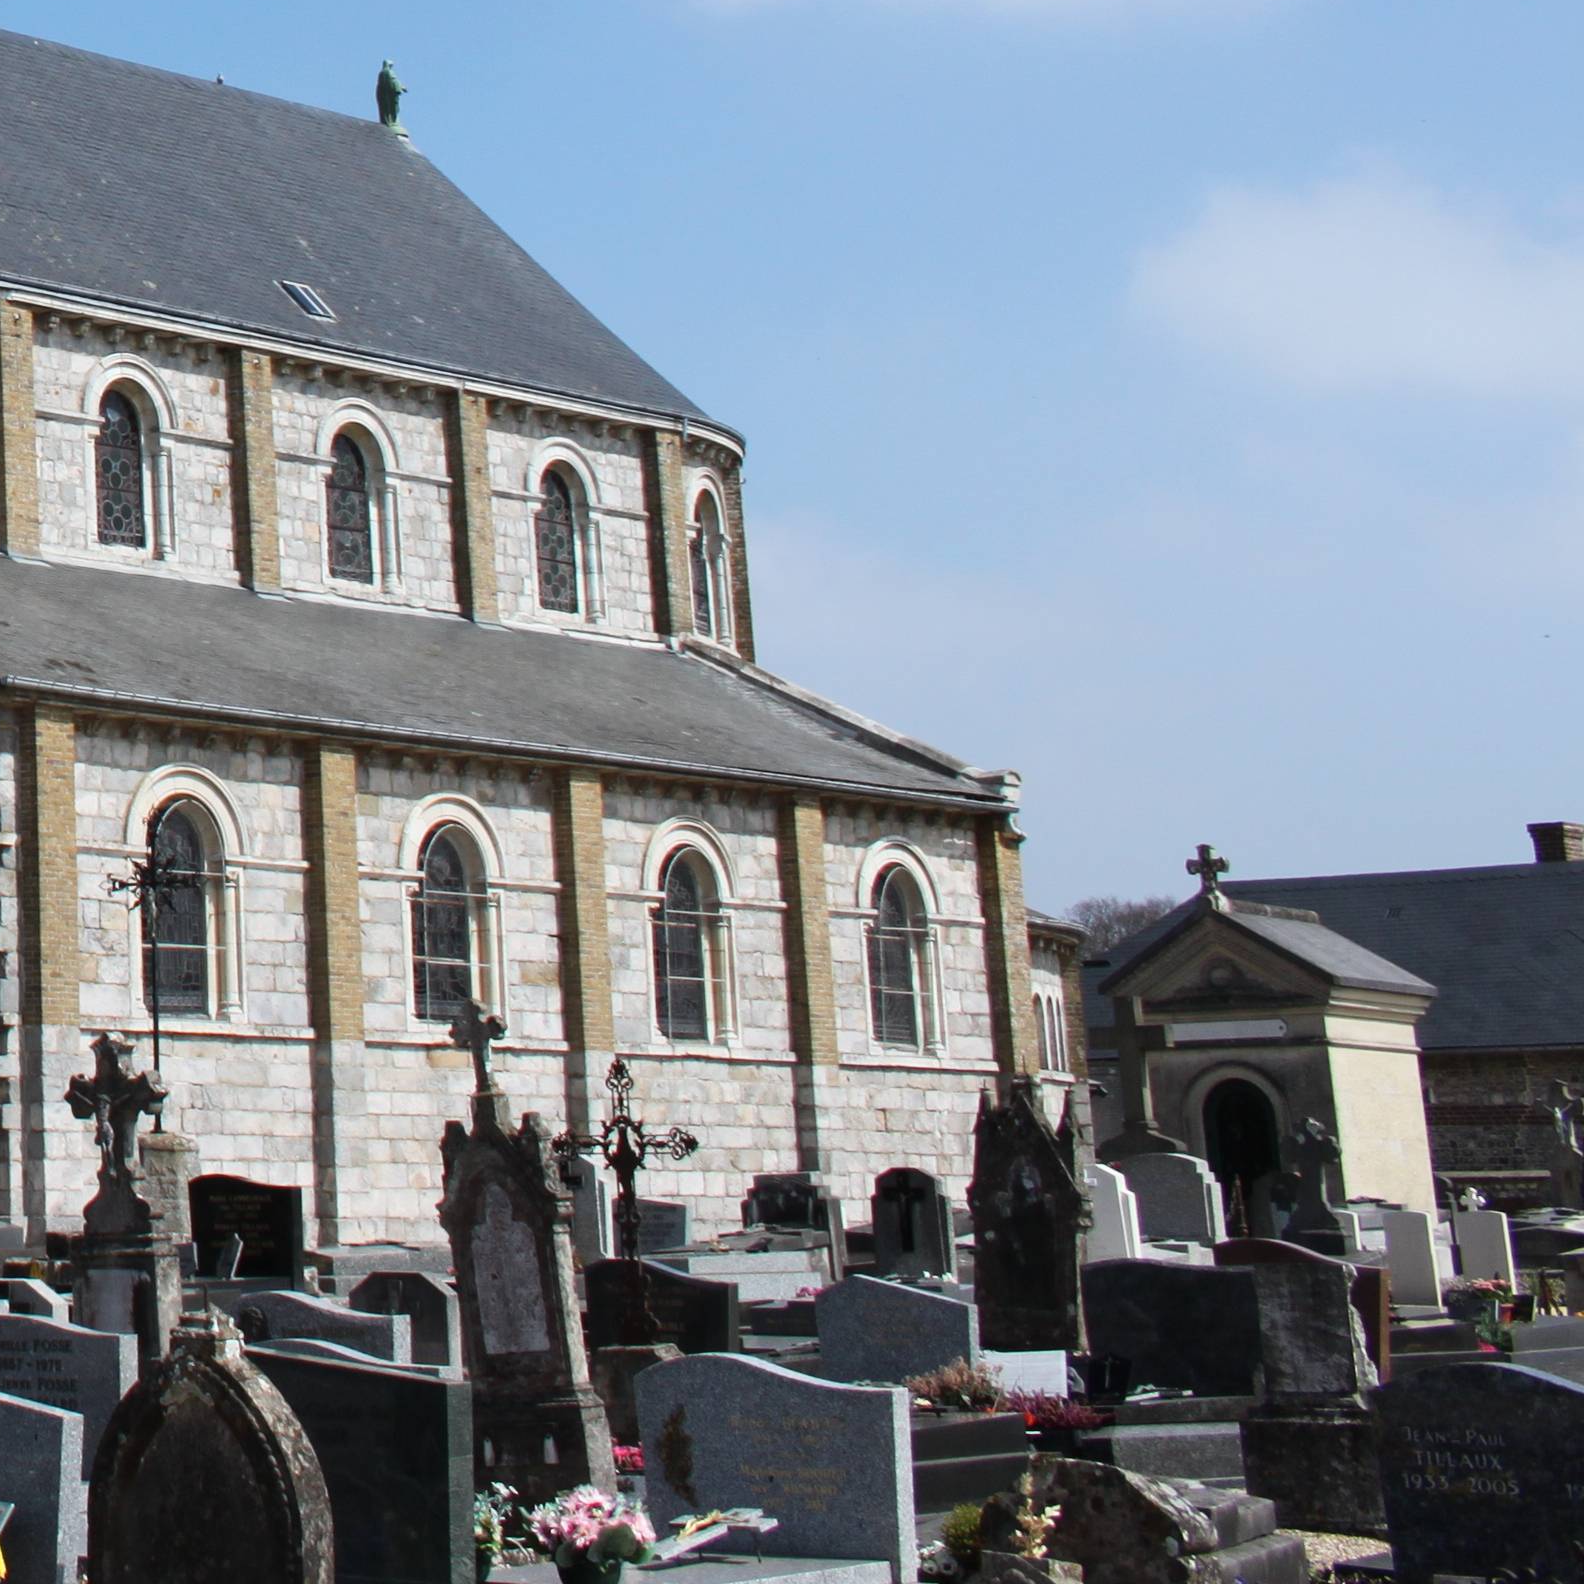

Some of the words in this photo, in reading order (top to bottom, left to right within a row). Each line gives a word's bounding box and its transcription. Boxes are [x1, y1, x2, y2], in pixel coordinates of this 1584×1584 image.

[1413, 1450, 1504, 1471] TILLAUX
[1401, 1472, 1449, 1490] 1933
[1468, 1476, 1520, 1496] 2005
